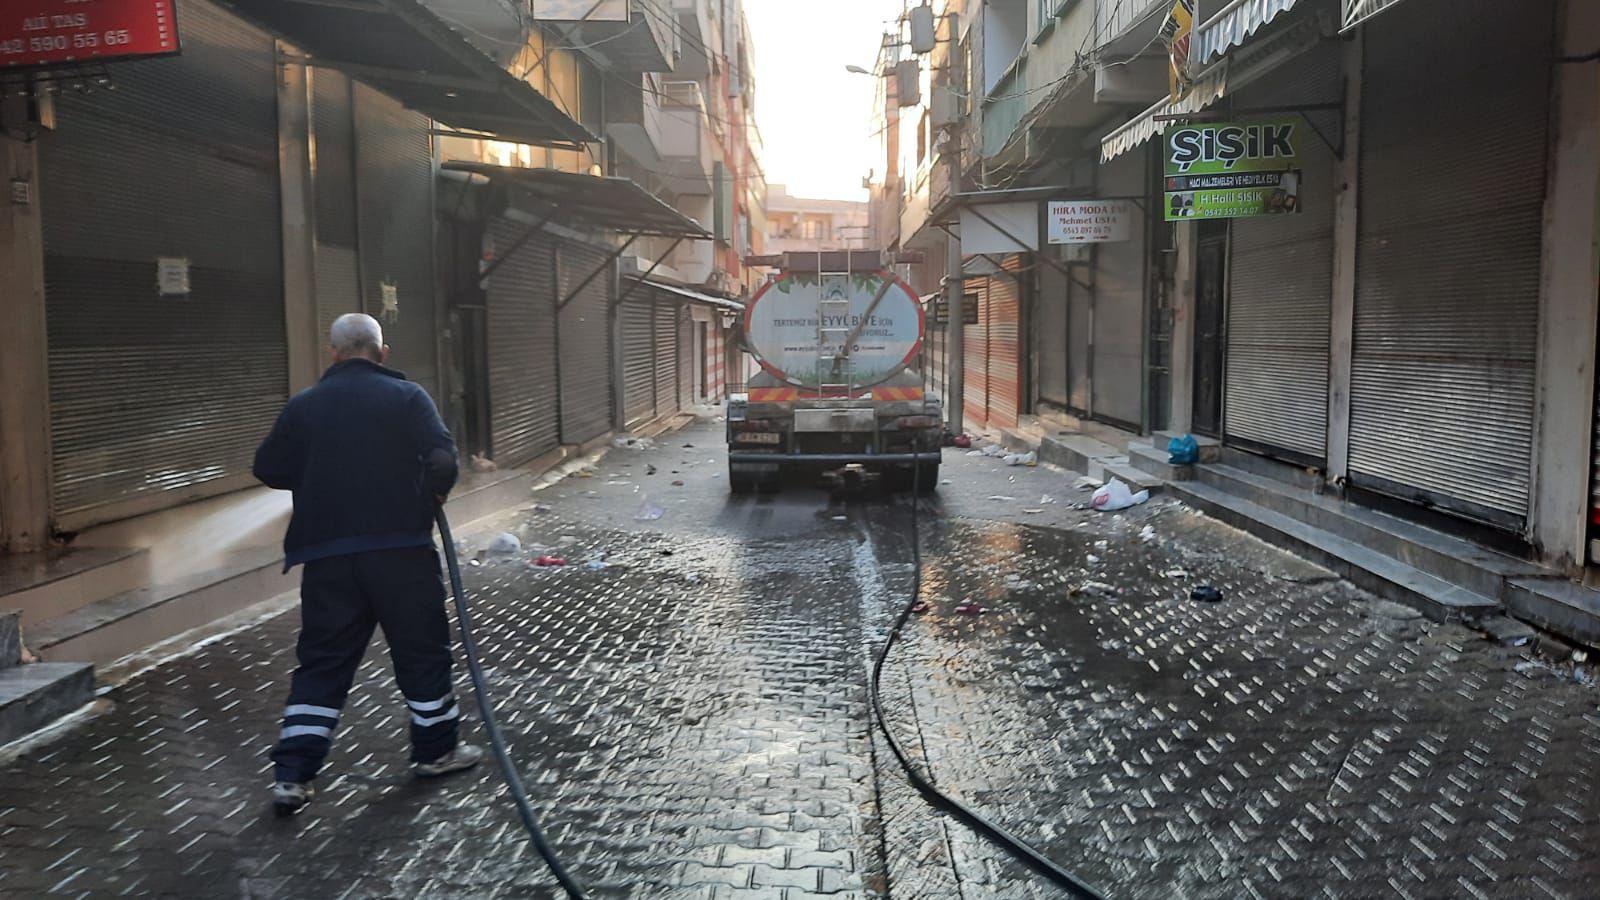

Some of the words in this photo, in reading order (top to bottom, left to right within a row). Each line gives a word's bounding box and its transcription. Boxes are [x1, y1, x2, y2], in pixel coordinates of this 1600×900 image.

[30, 35, 67, 52] 590
[73, 32, 98, 48] 55
[104, 29, 130, 46] 65
[1170, 123, 1296, 173] ŞİŞİK
[1080, 206, 1108, 215] MODA
[1059, 217, 1092, 225] Mehmet
